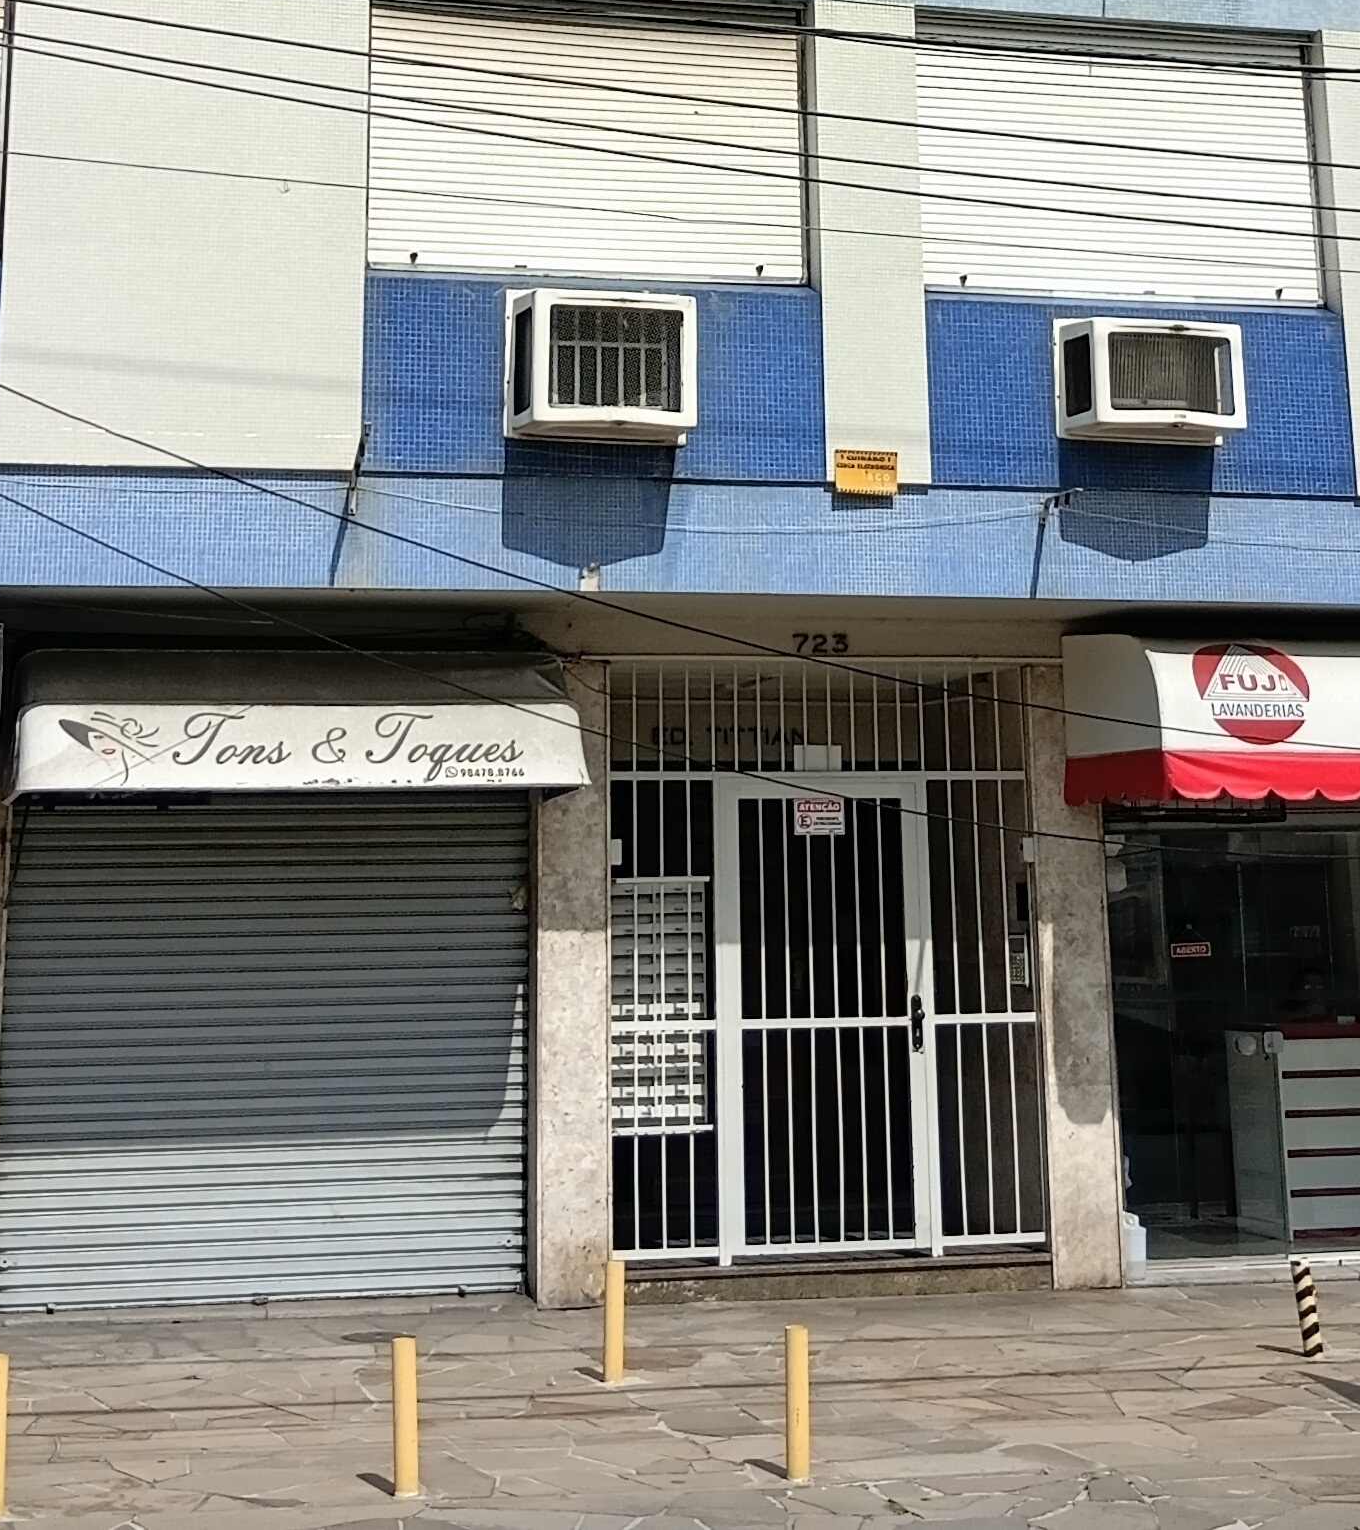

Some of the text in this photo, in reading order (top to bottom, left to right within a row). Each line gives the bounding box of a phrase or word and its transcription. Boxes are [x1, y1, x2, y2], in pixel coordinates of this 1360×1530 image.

[792, 633, 849, 653] 723
[1219, 673, 1288, 692] FUJI
[1211, 702, 1305, 718] LAVANDERIAS
[172, 712, 525, 782] Tons & Toques
[798, 801, 841, 812] ATENÇÃO
[1175, 945, 1207, 955] ABERTO
